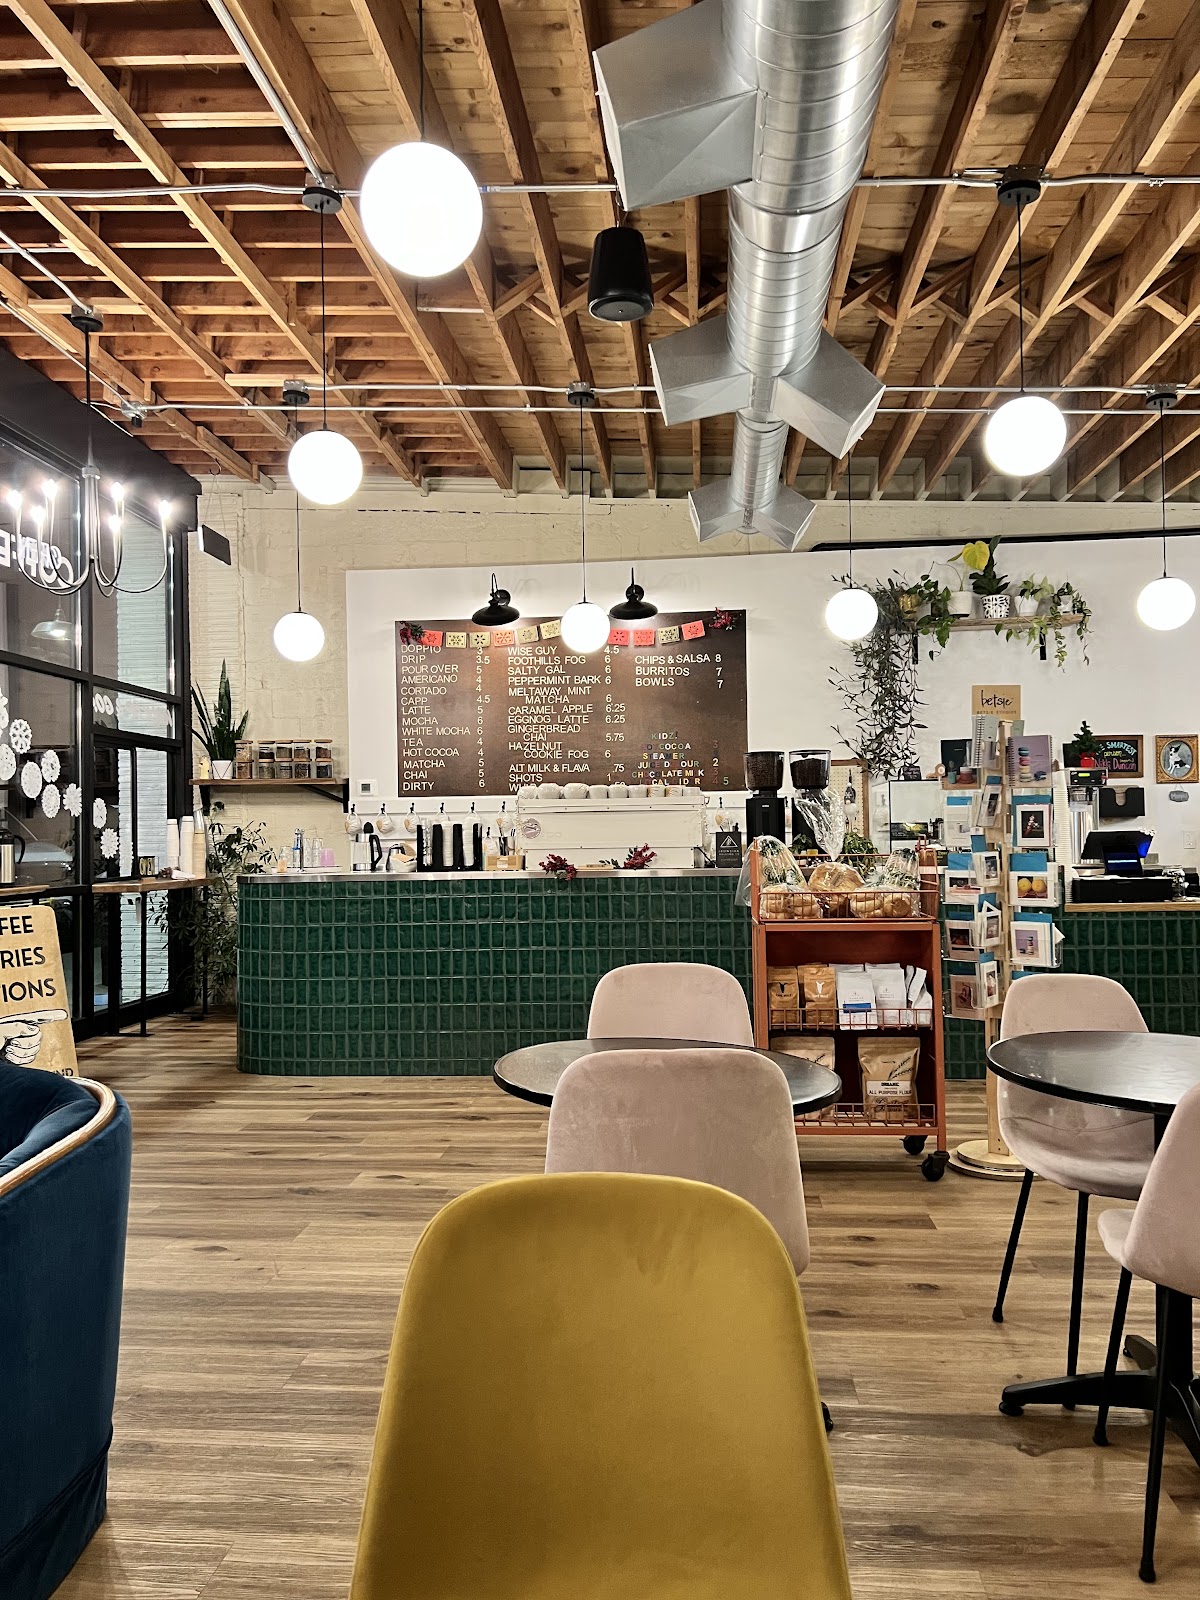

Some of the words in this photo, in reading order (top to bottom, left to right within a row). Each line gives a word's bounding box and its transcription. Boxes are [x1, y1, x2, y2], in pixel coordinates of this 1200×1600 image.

[401, 645, 441, 653] DOPPIO
[477, 647, 483, 655] 3
[508, 647, 533, 656] WISE
[535, 646, 557, 655] GUY
[604, 646, 619, 654] 4.5
[476, 656, 490, 664] 3.5
[508, 657, 560, 665] FOOTHILLS
[564, 656, 586, 664] FOG
[605, 655, 611, 663] 6
[635, 656, 665, 664] CHIPS
[668, 655, 674, 664] &
[676, 654, 710, 663] SALSA
[715, 654, 721, 662] 8
[402, 666, 429, 674] POUR
[431, 665, 458, 673] OVER
[476, 666, 482, 674] 5
[508, 666, 540, 675] SALTY
[545, 665, 566, 674] GAL
[636, 667, 690, 676] BURRITOS
[716, 668, 723, 676] 7
[401, 674, 458, 684] AMERICANO
[508, 675, 571, 685] PEPPERMINT
[574, 675, 601, 684] BARK
[605, 676, 611, 684] 6
[636, 678, 674, 687] BOWLS
[717, 680, 723, 689] 7
[401, 686, 447, 695] CORTADO
[508, 687, 561, 696] MELTAWAY
[568, 686, 591, 695] MINT
[401, 697, 428, 705] CAPP
[477, 695, 490, 703] 4.5
[525, 695, 569, 704] MATCHA
[606, 694, 612, 703] 6
[979, 689, 1013, 708] betsie
[402, 706, 430, 715] LATTE
[478, 706, 483, 714] 5
[508, 706, 556, 715] CARAMEL
[562, 704, 593, 713] APPLE
[606, 703, 626, 713] 6.25
[402, 717, 438, 726] MOCHA
[478, 716, 483, 725] 6
[508, 715, 550, 724] EGGNOG
[558, 715, 589, 723] LATTE
[606, 715, 625, 723] 6.25
[402, 727, 433, 736] WHITE
[436, 727, 470, 735] MOCHA
[477, 727, 483, 735] 6
[508, 725, 580, 733] GINGERBREAD
[402, 738, 423, 746] TEA
[523, 733, 546, 741] CHAI
[606, 733, 624, 741] 5.75
[509, 742, 562, 750] HAZELNUT
[1105, 741, 1137, 756] SMARTEST
[403, 748, 422, 756] HOT
[425, 748, 459, 756] COCOA
[478, 748, 483, 756] 4
[524, 750, 562, 758] COOKIE
[568, 750, 589, 758] FOG
[605, 750, 611, 758] 6
[404, 759, 445, 769] MATCHA
[478, 759, 484, 767] 5
[713, 758, 718, 766] 2
[509, 764, 525, 772] ALT
[527, 763, 550, 772] MILK
[553, 764, 559, 772] &
[562, 763, 590, 772] FLAVA
[404, 771, 427, 780] CHAI
[479, 769, 484, 777] 5
[509, 773, 542, 782] SHOTS
[607, 773, 611, 782] 1
[403, 782, 434, 791] DIRTY
[479, 779, 485, 788] 6
[0, 978, 56, 1002] IONS
